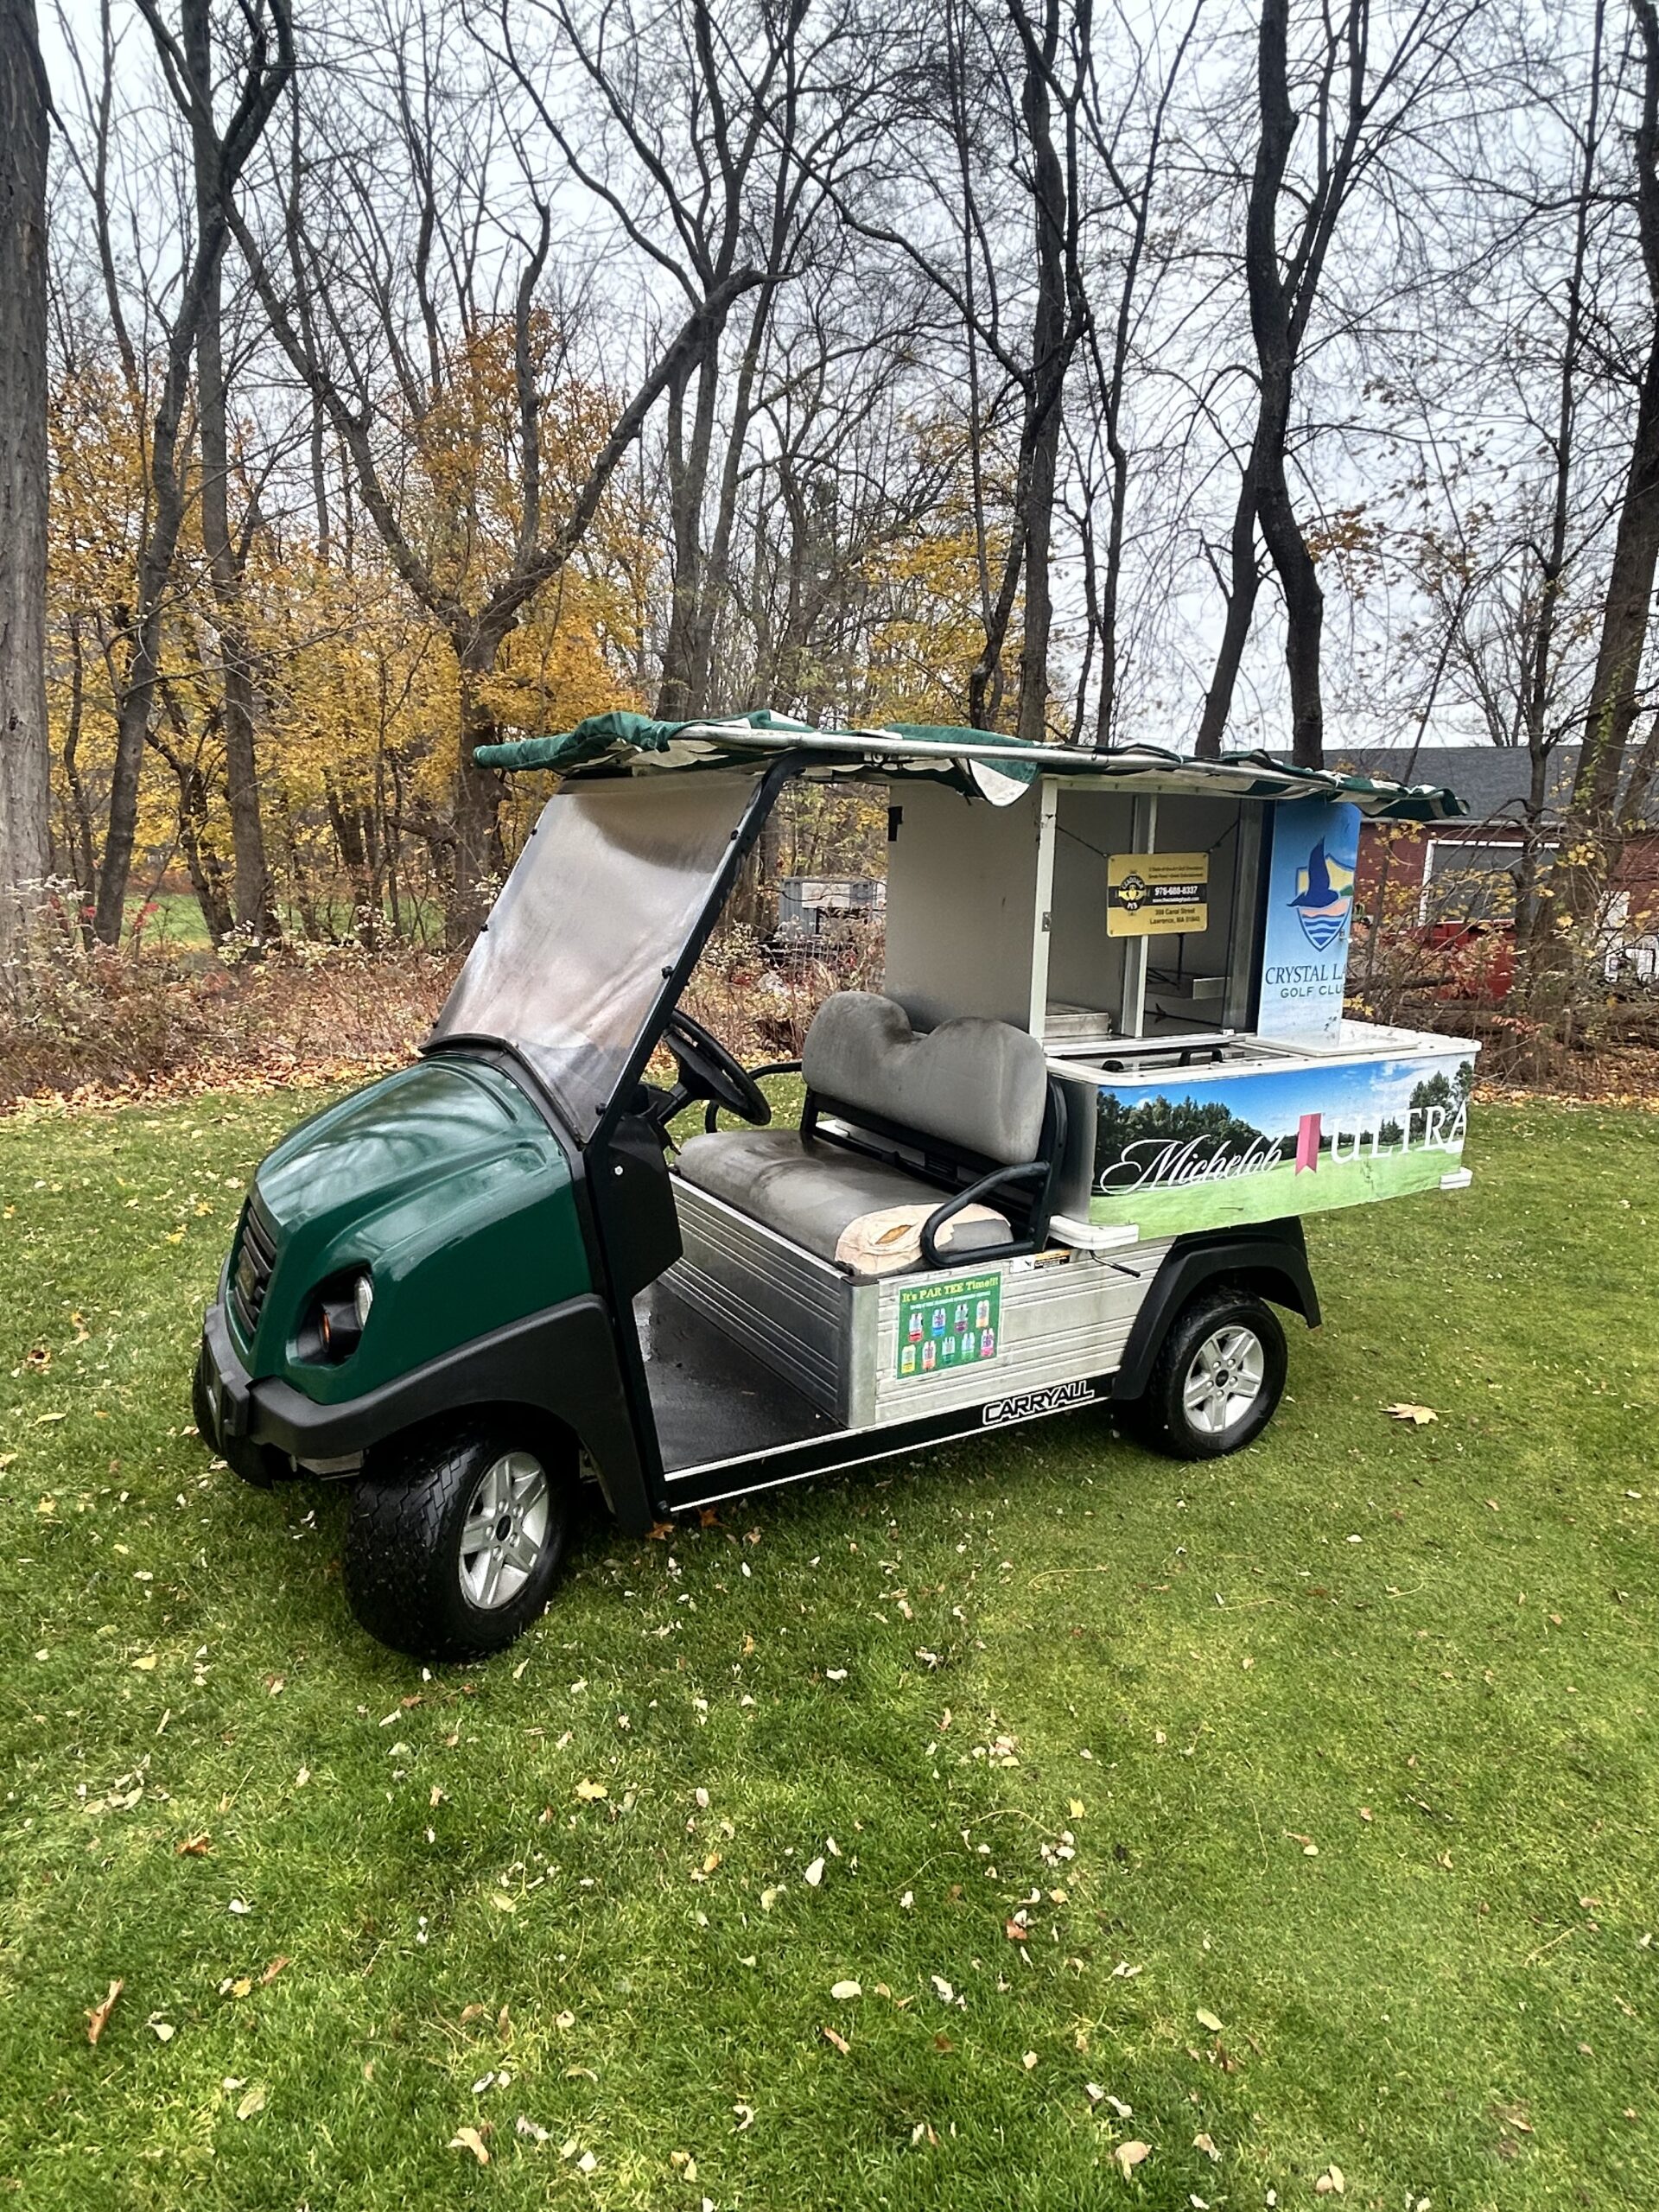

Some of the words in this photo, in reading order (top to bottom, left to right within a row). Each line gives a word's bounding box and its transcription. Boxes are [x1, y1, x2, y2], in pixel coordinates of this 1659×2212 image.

[1265, 963, 1329, 985] CRYSTAL
[1280, 986, 1315, 999] GOLF
[1100, 1133, 1283, 1196] Michelob
[1329, 1098, 1467, 1166] ULTRA
[901, 1291, 918, 1303] It's
[919, 1287, 943, 1300] PAR
[944, 1282, 964, 1295] TEE
[982, 1380, 1095, 1425] CARRYALL
